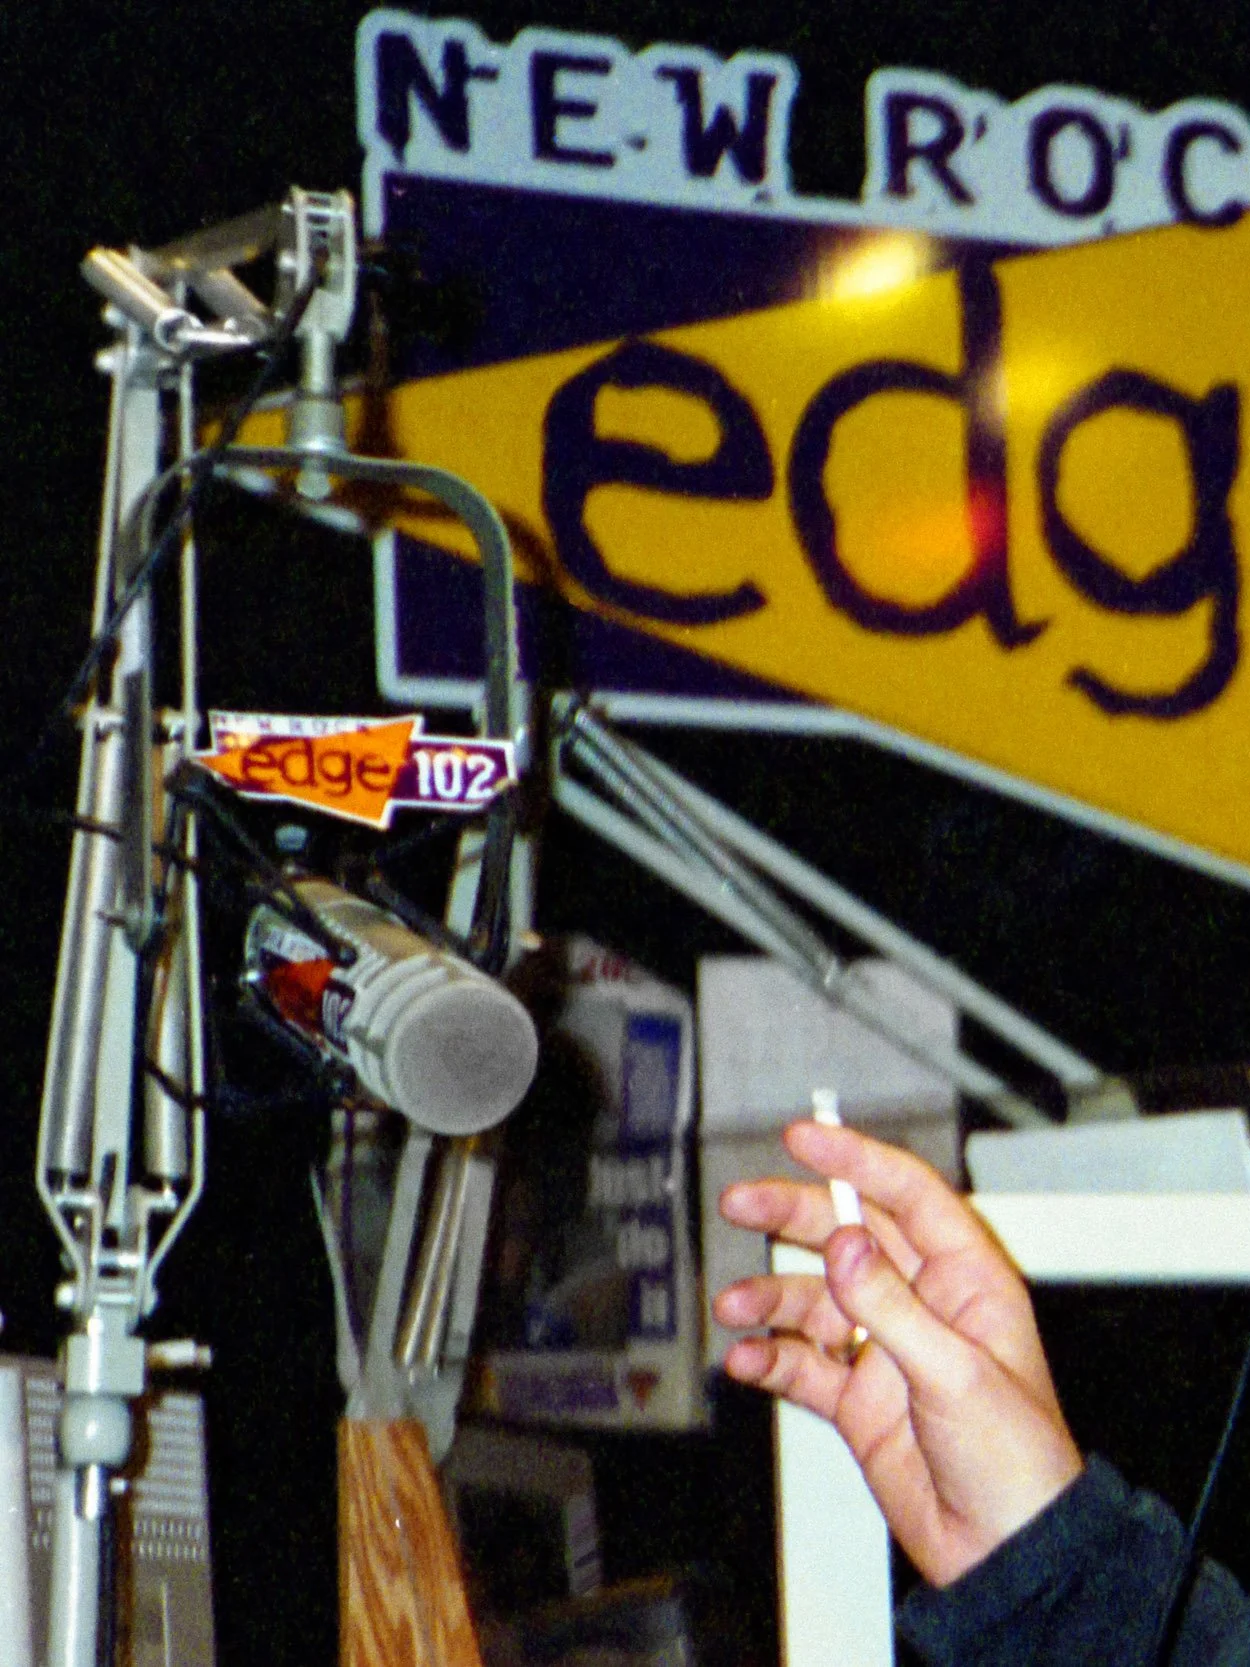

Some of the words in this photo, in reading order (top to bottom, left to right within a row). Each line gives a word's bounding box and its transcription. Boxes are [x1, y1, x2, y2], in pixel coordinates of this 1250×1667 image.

[374, 30, 777, 185] NEW
[241, 737, 391, 797] edge
[412, 750, 496, 799] 102
